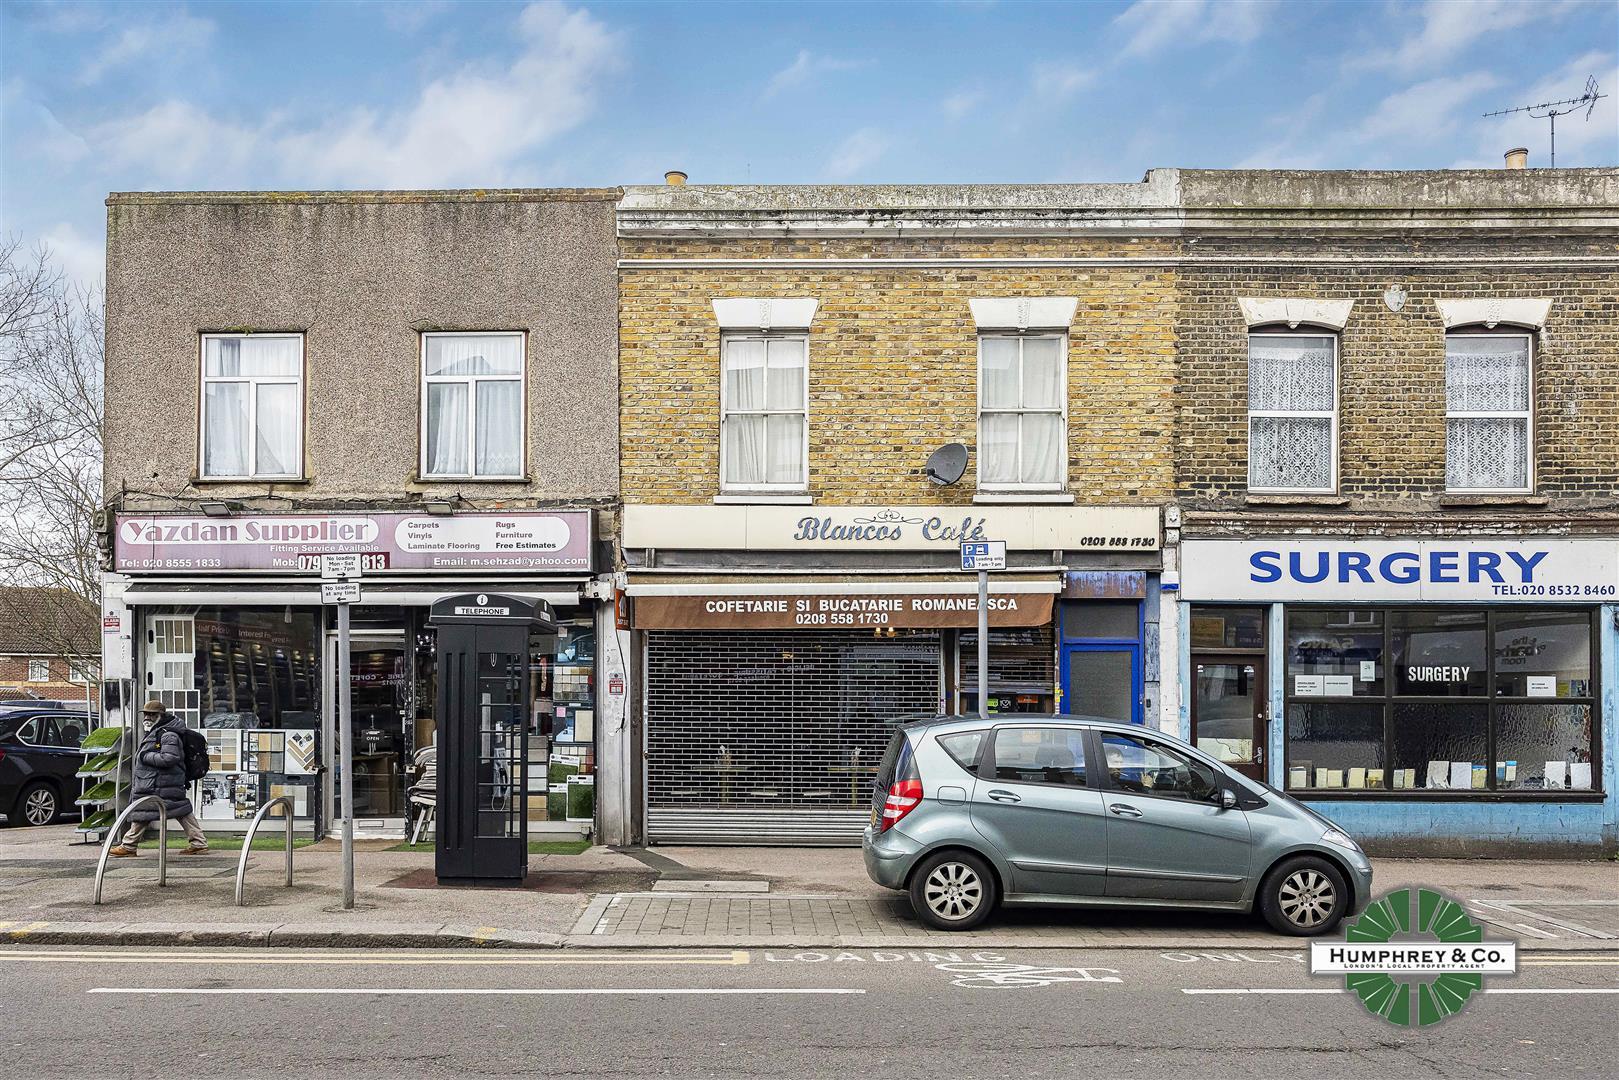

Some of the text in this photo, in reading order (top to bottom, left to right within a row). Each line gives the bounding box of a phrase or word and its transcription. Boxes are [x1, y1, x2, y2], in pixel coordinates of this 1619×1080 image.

[128, 520, 369, 542] Yazdan Supplier
[794, 516, 987, 542] Blancos Café
[408, 532, 432, 540] Vinyls
[496, 531, 533, 539] Furniture
[270, 543, 379, 553] Fitting Service Available
[408, 542, 481, 551] Laminate Flooring
[120, 558, 221, 567] Tel: 020 8555 1833
[273, 558, 297, 567] Mob:
[434, 557, 588, 567] Email: m.sehzad@yahoo.com
[1249, 551, 1550, 584] SURGERY
[1548, 585, 1580, 595] 8532
[1584, 585, 1615, 595] 8460
[705, 600, 788, 613] COFETARIE
[796, 600, 810, 612] SI
[819, 599, 903, 612] BUCATARIE
[796, 612, 889, 625] 0208 558 1730
[1408, 666, 1471, 681] SURGERY
[764, 951, 1008, 963] LOADING
[1159, 951, 1305, 963] ONLY
